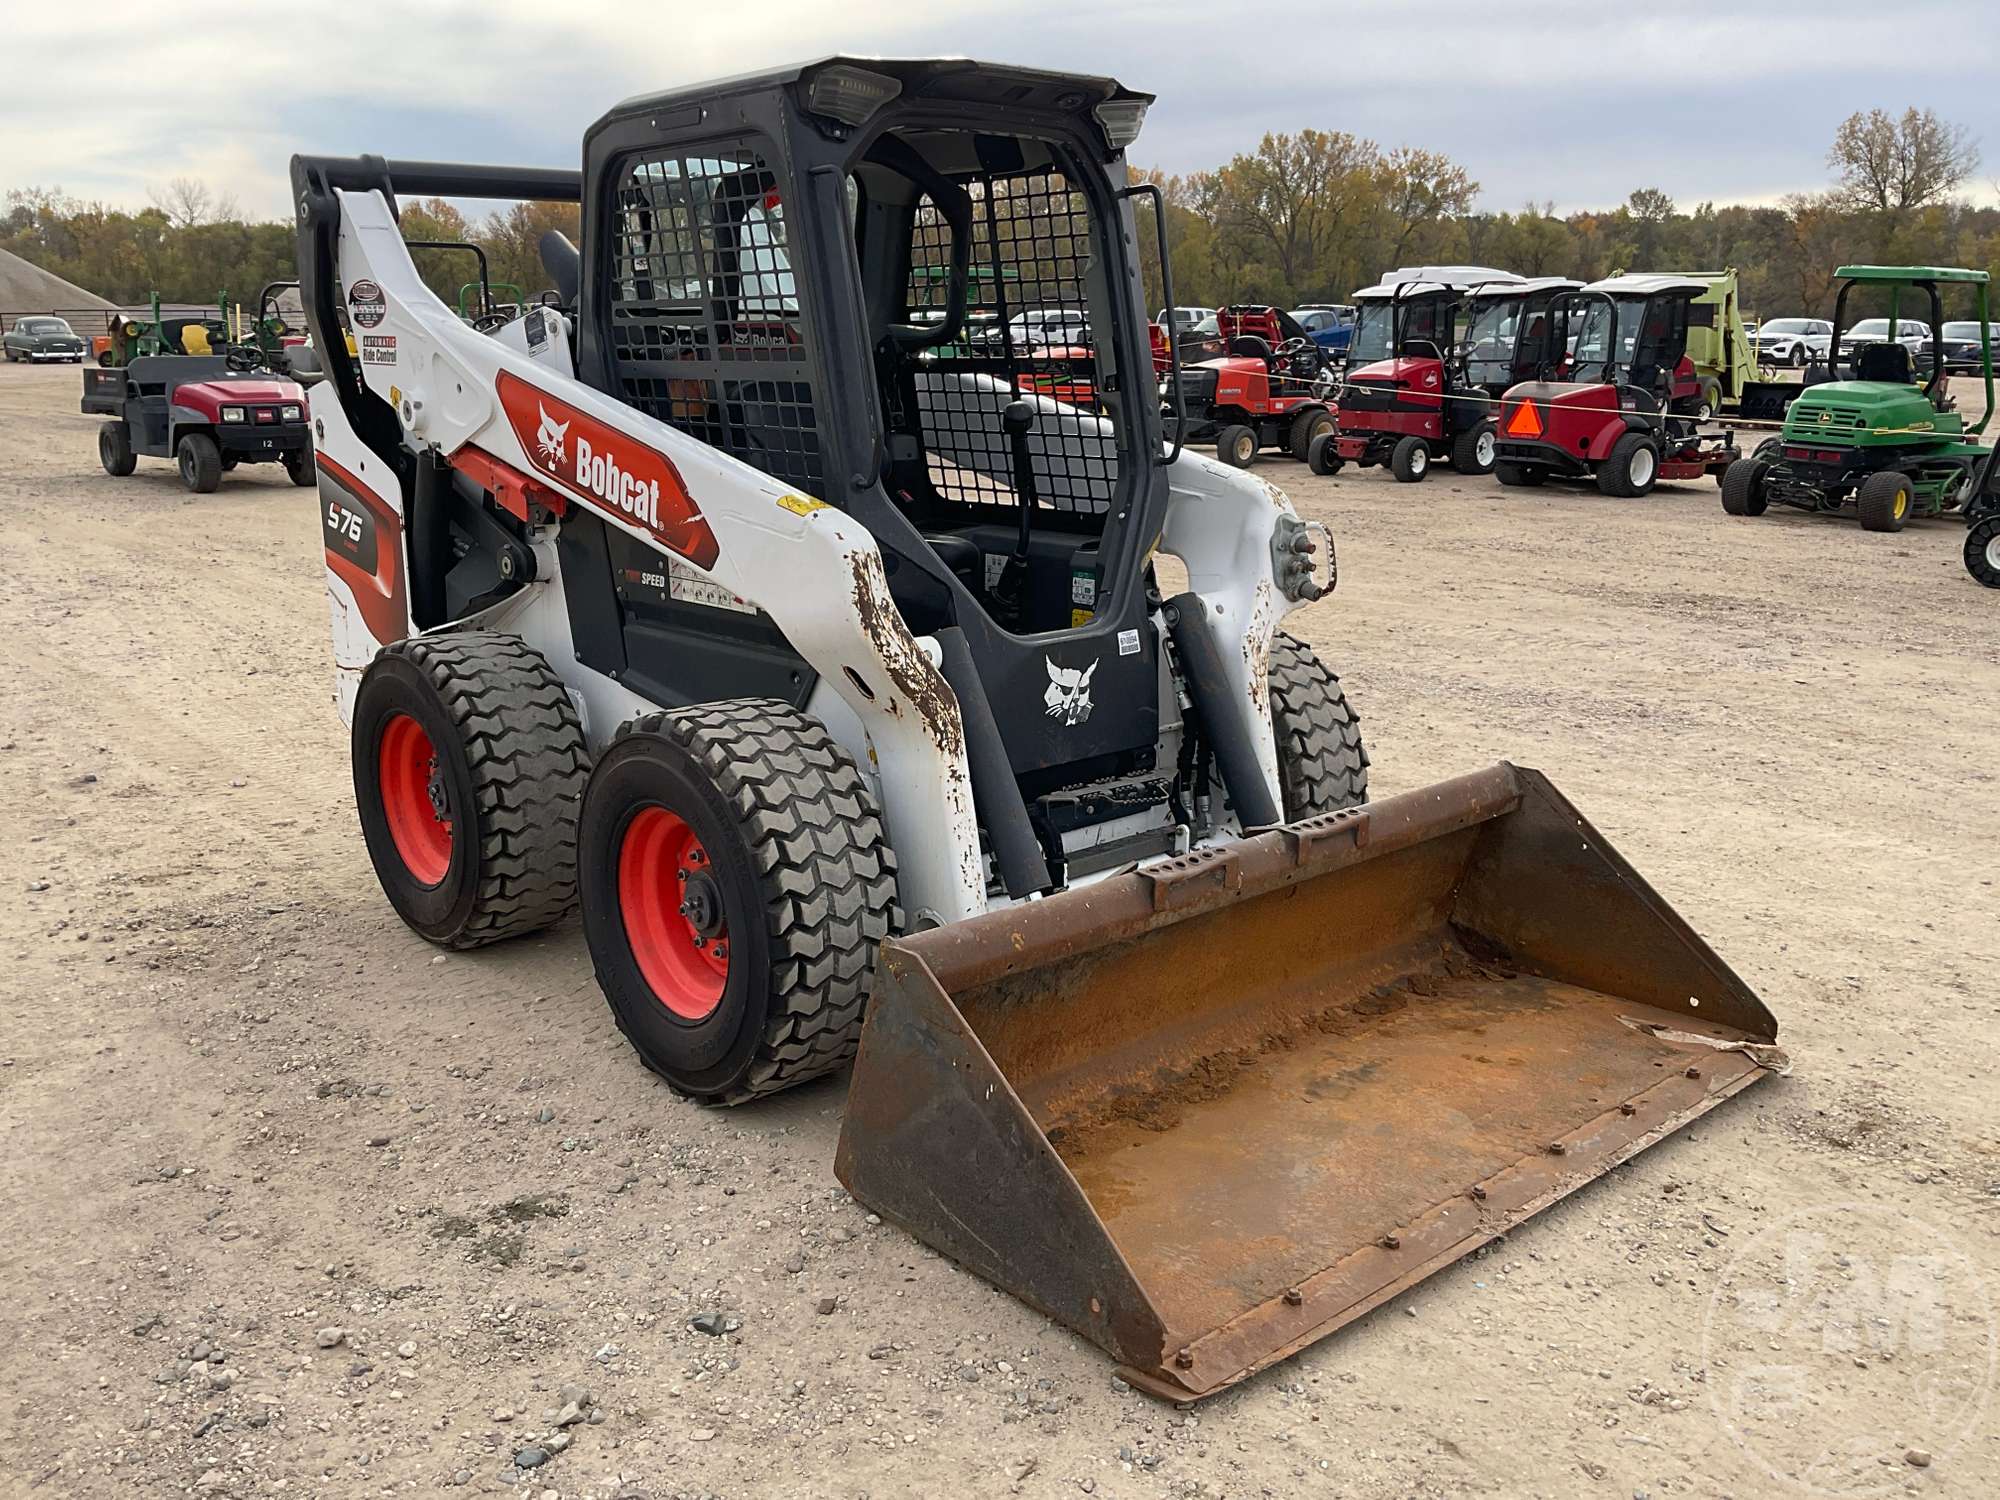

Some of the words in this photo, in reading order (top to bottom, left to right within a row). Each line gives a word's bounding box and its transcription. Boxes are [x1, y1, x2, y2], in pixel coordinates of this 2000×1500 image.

[364, 336, 396, 348] AUTOMATIC
[363, 348, 375, 362] Ride
[376, 349, 397, 363] Control
[263, 440, 273, 448] 12
[576, 436, 661, 529] Bobcat
[328, 502, 363, 542] S76
[641, 572, 665, 588] SPEED
